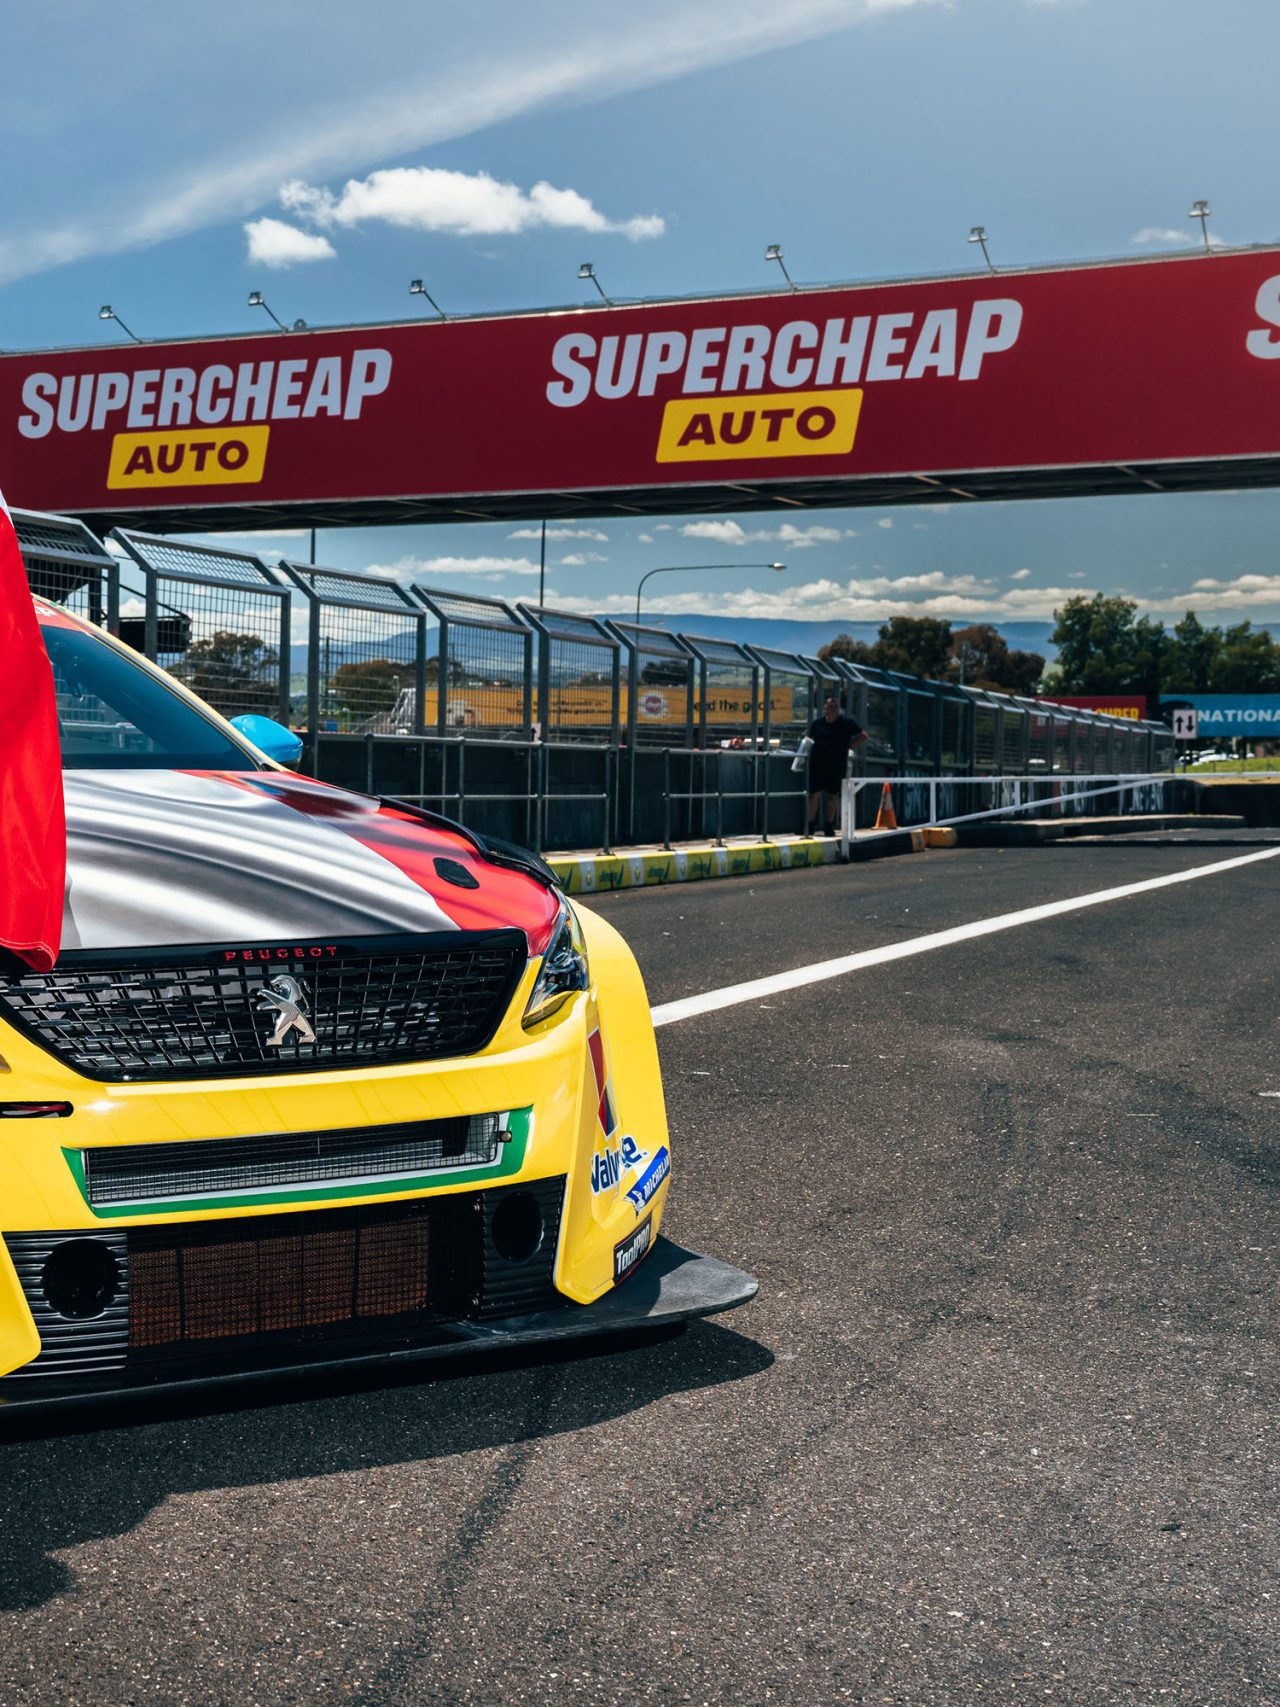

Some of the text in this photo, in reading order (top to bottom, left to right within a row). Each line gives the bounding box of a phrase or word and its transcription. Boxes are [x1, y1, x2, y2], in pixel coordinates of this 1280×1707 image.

[546, 298, 1023, 408] SUPERCHEAP
[18, 348, 393, 439] SUPERCHEAP
[676, 405, 837, 447] AUTO
[122, 440, 250, 476] AUTO
[224, 945, 337, 960] PEUGEOT
[615, 1222, 651, 1276] ToolPRO
